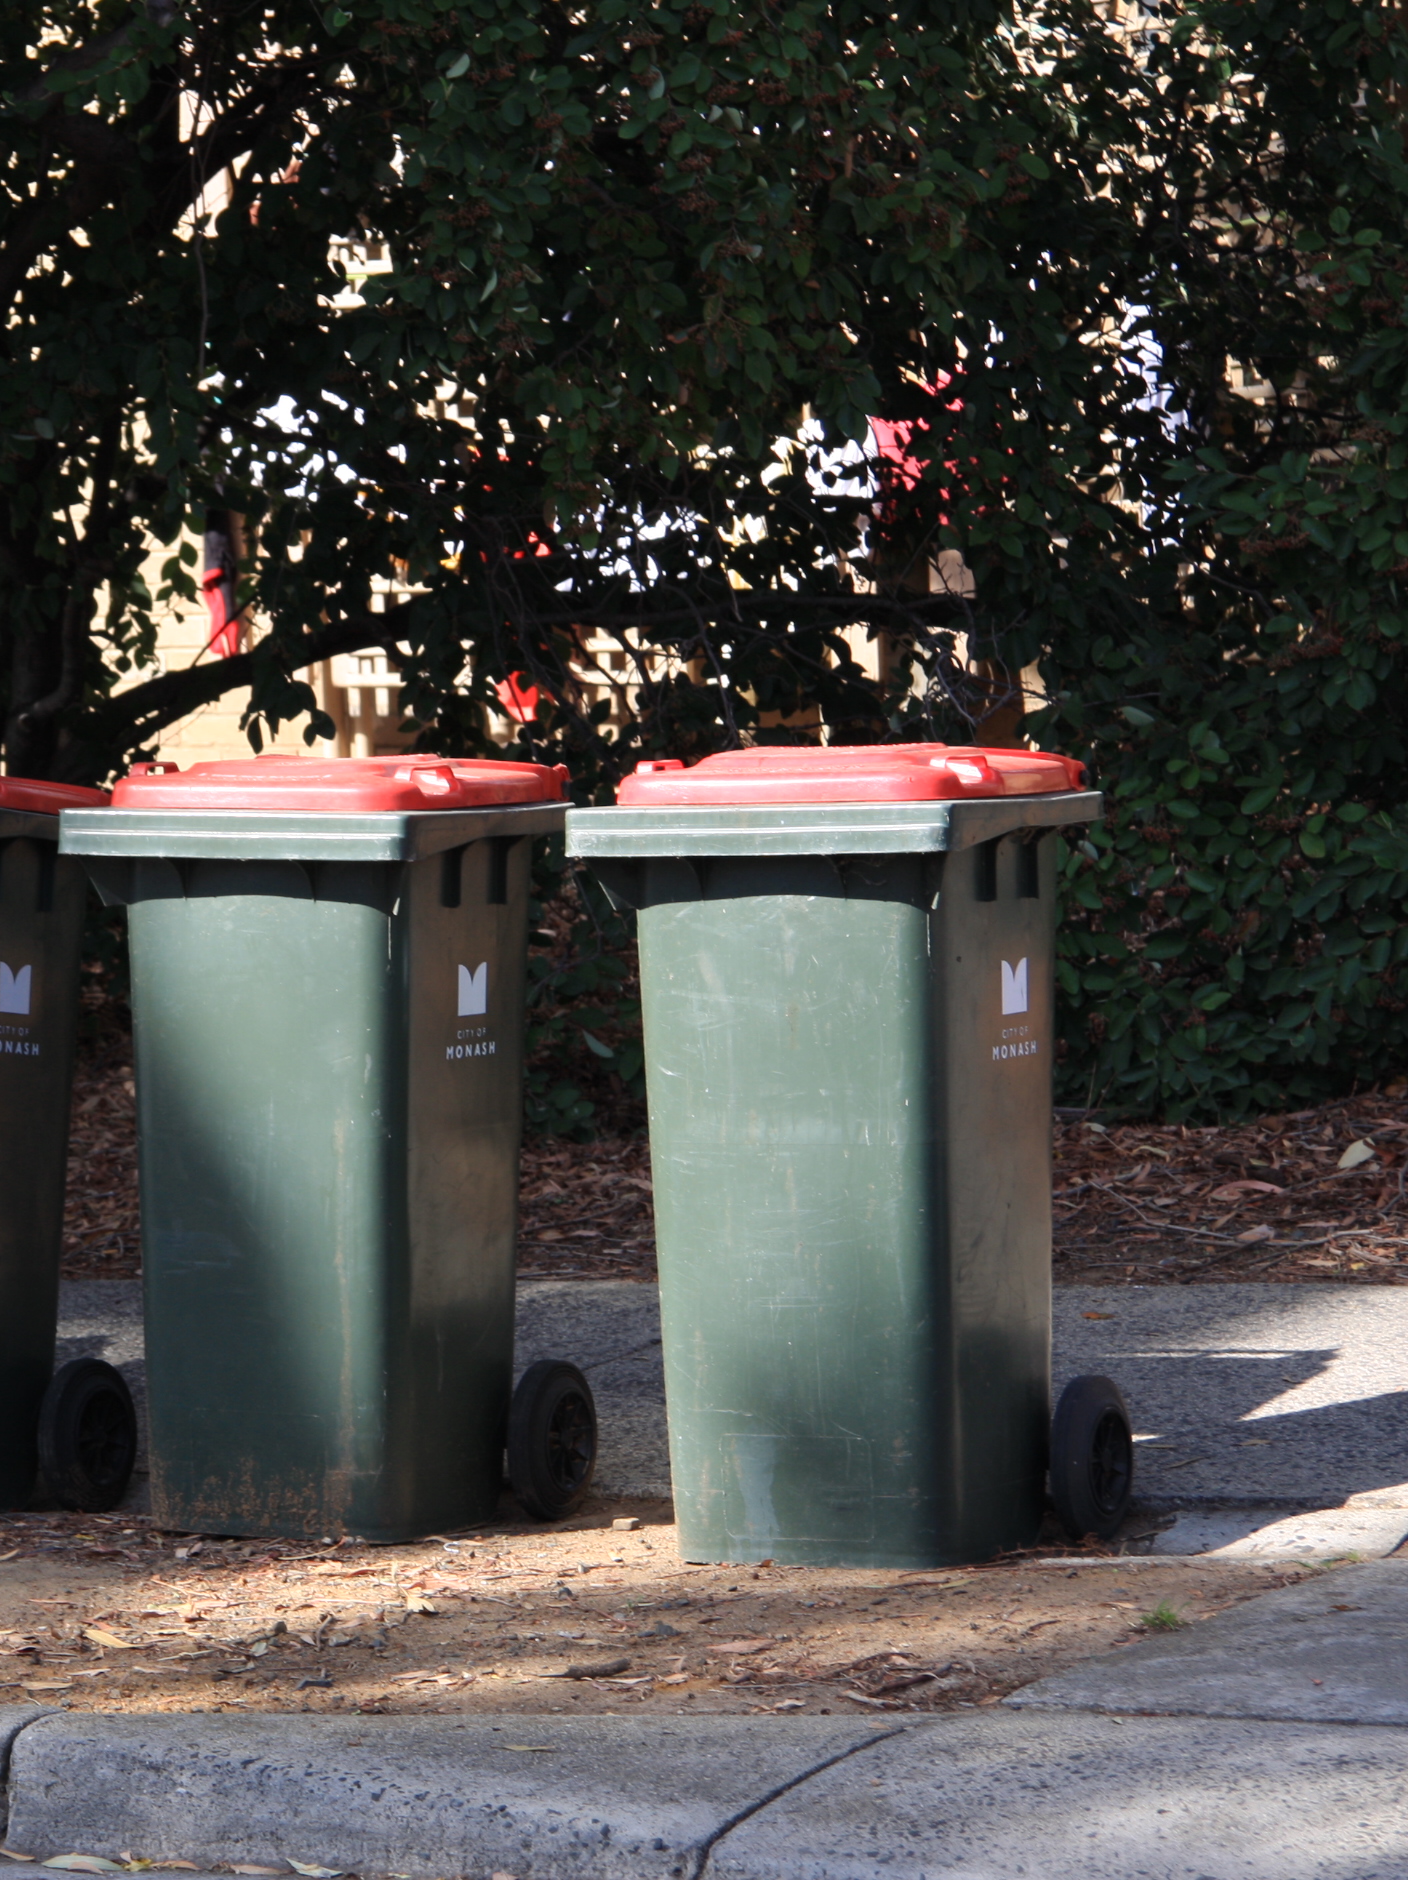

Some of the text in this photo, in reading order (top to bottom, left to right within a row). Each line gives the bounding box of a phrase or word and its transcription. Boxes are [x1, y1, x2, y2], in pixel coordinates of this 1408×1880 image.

[18, 1027, 30, 1037] OF
[457, 1027, 487, 1040] CITY OF
[1001, 1025, 1029, 1039] CITY OF
[446, 1041, 495, 1060] MONASH
[992, 1040, 1037, 1061] MONASH
